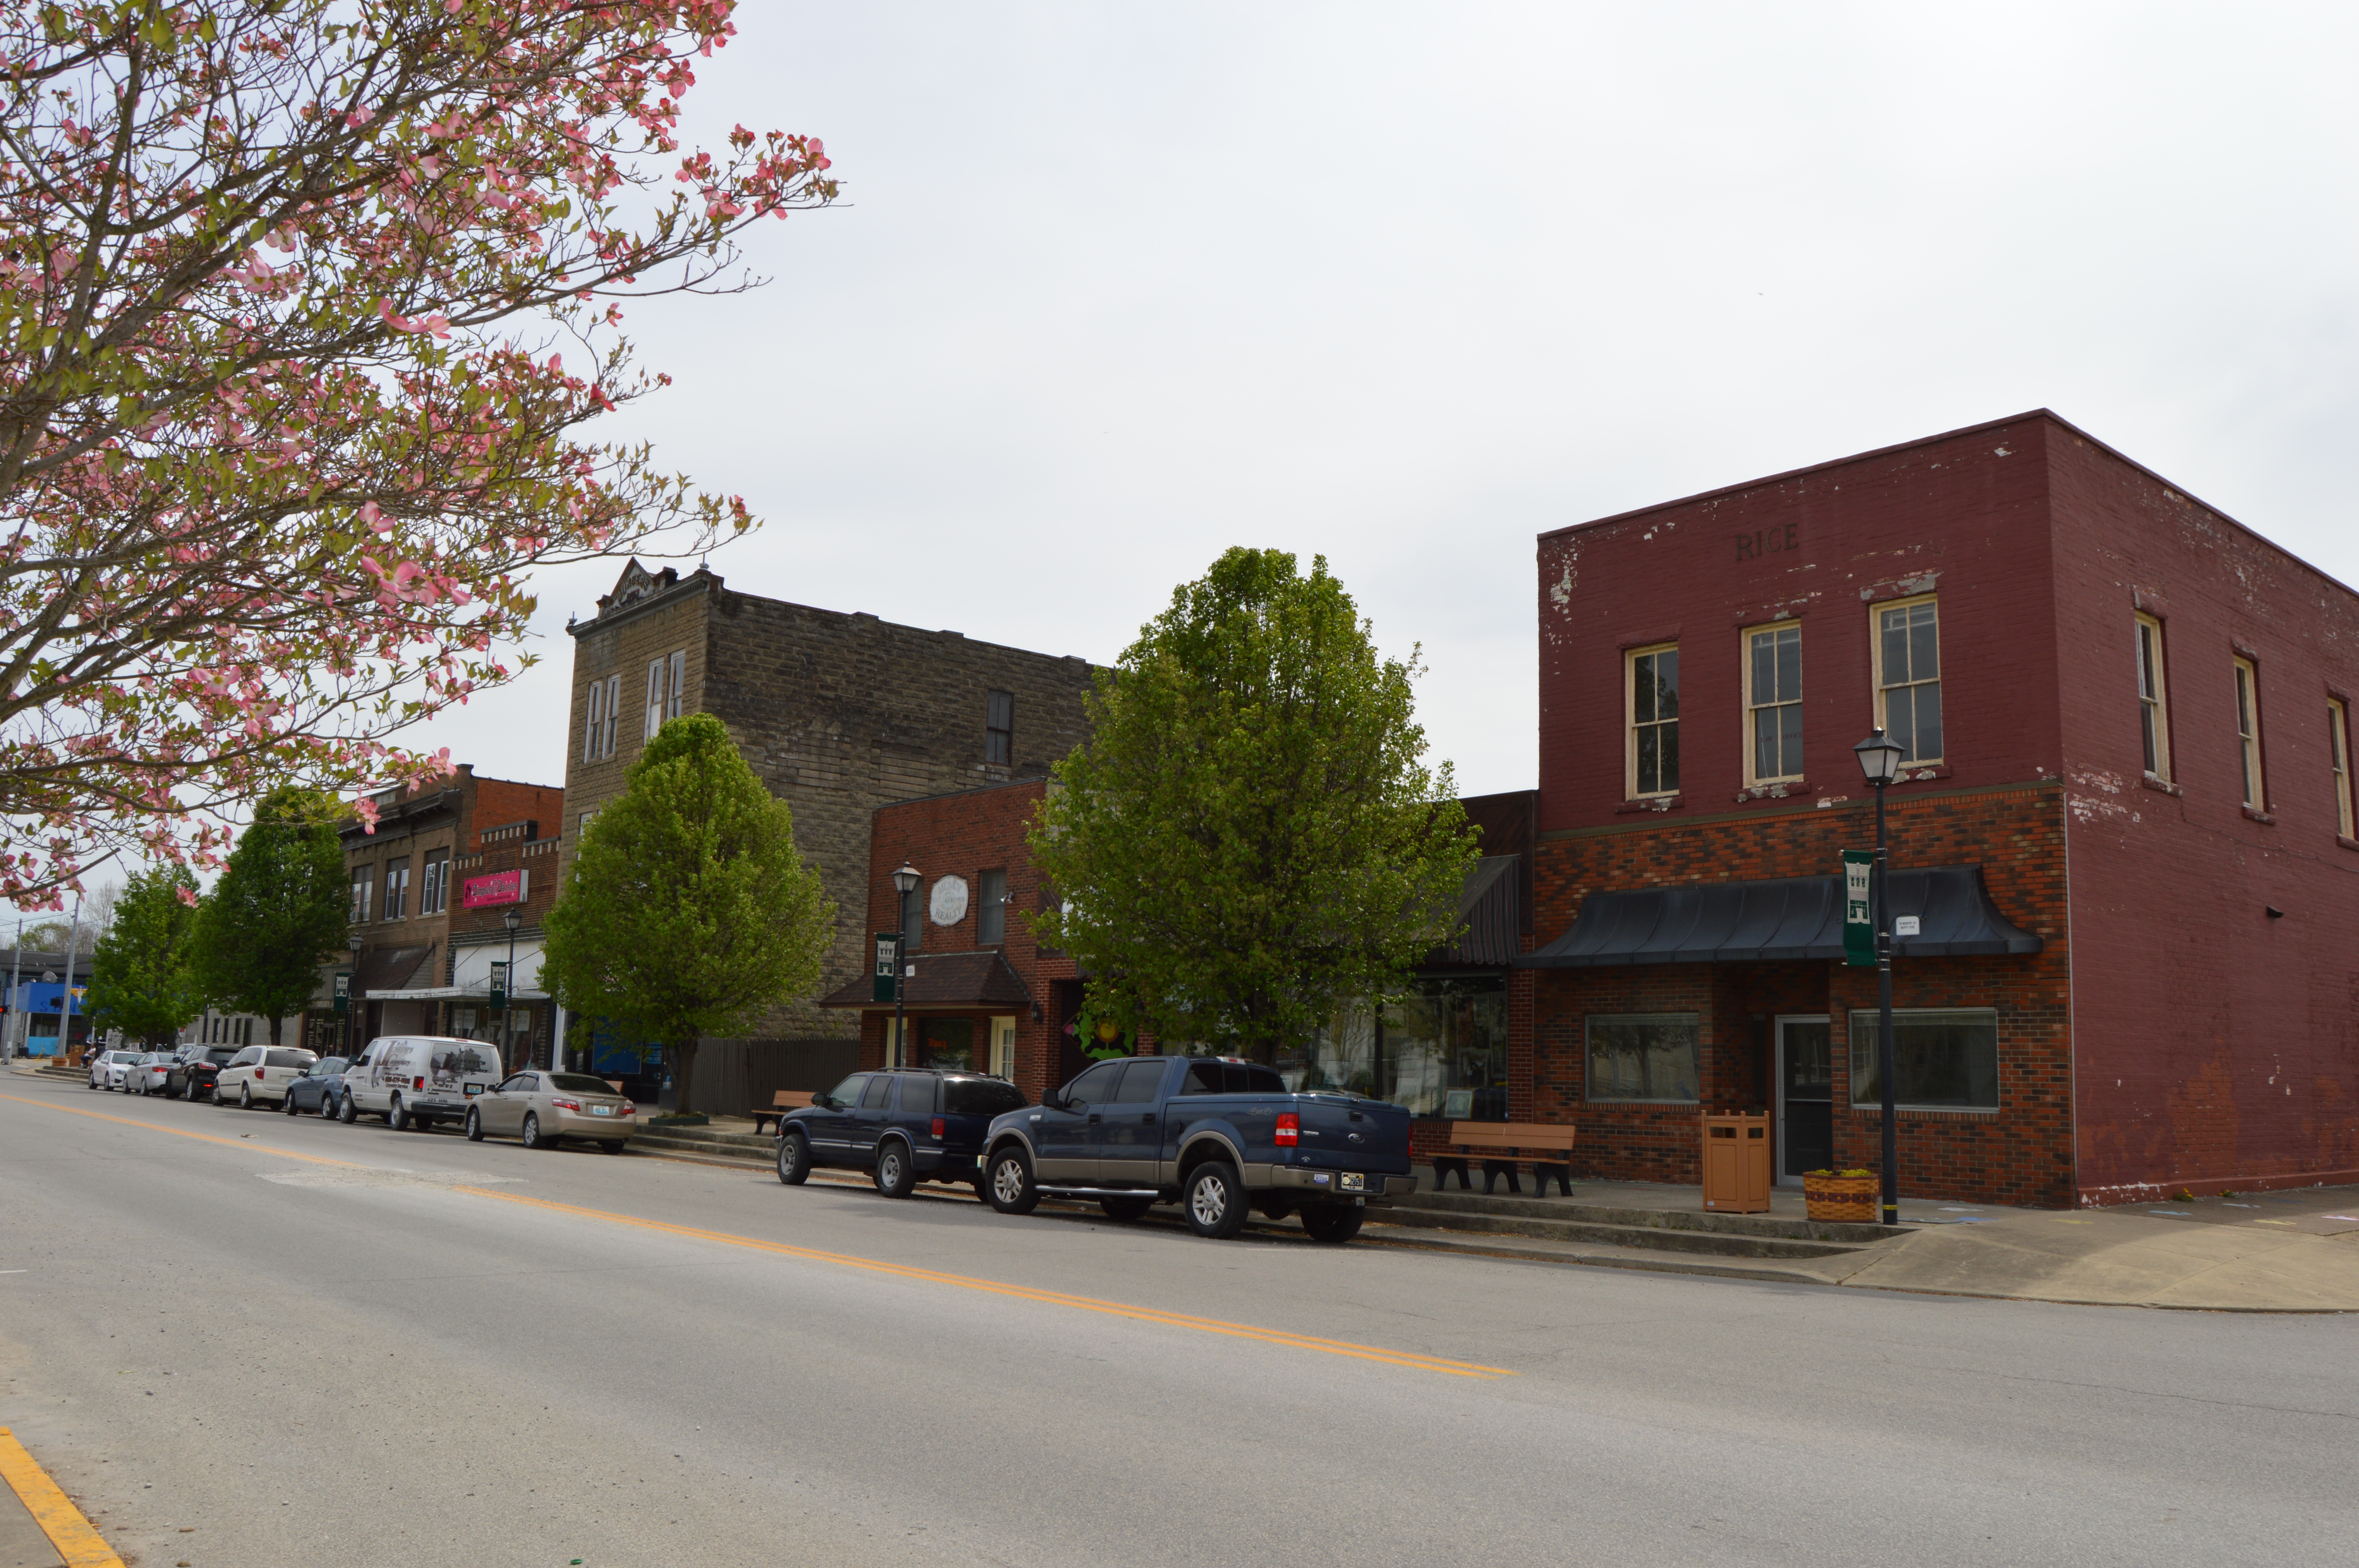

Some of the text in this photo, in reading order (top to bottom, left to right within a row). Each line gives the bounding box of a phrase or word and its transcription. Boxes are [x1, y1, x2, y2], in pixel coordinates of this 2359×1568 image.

[1736, 523, 1799, 561] RICE
[472, 883, 491, 898] Dimples
[498, 879, 518, 893] Daisies
[938, 881, 962, 893] MUNCY
[936, 905, 961, 920] REALTY
